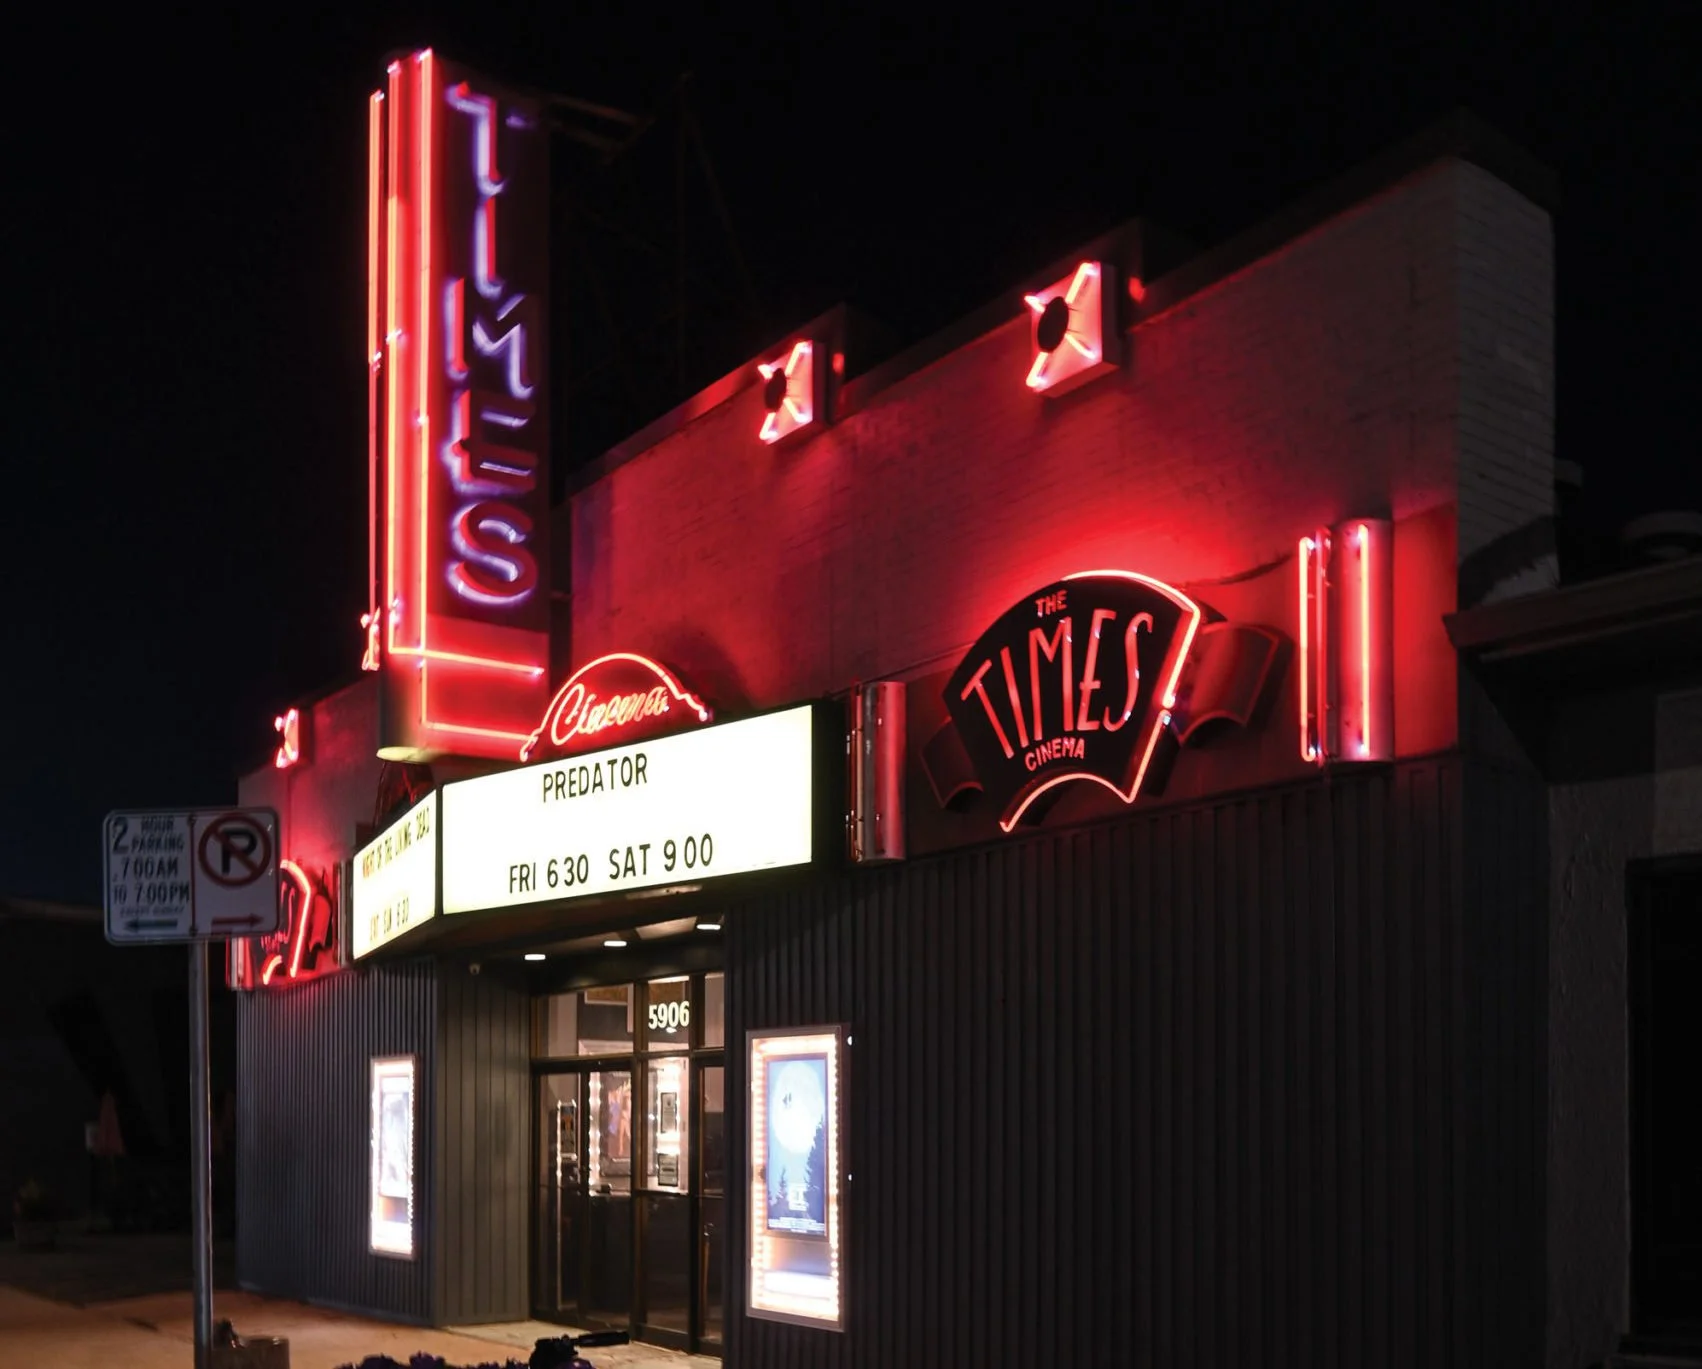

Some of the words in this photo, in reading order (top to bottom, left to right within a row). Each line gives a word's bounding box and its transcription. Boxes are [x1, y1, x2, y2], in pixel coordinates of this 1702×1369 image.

[446, 81, 535, 605] TIMES
[1035, 589, 1067, 618] THE
[961, 608, 1153, 759] TIMES
[1025, 737, 1085, 772] CINEMA
[543, 752, 648, 803] PREDATOR
[112, 816, 129, 854] 2
[141, 816, 174, 832] HOUR
[131, 834, 185, 854] PARKING
[509, 864, 536, 894] FRI
[609, 843, 651, 880] SAT
[648, 1001, 690, 1030] 5906
